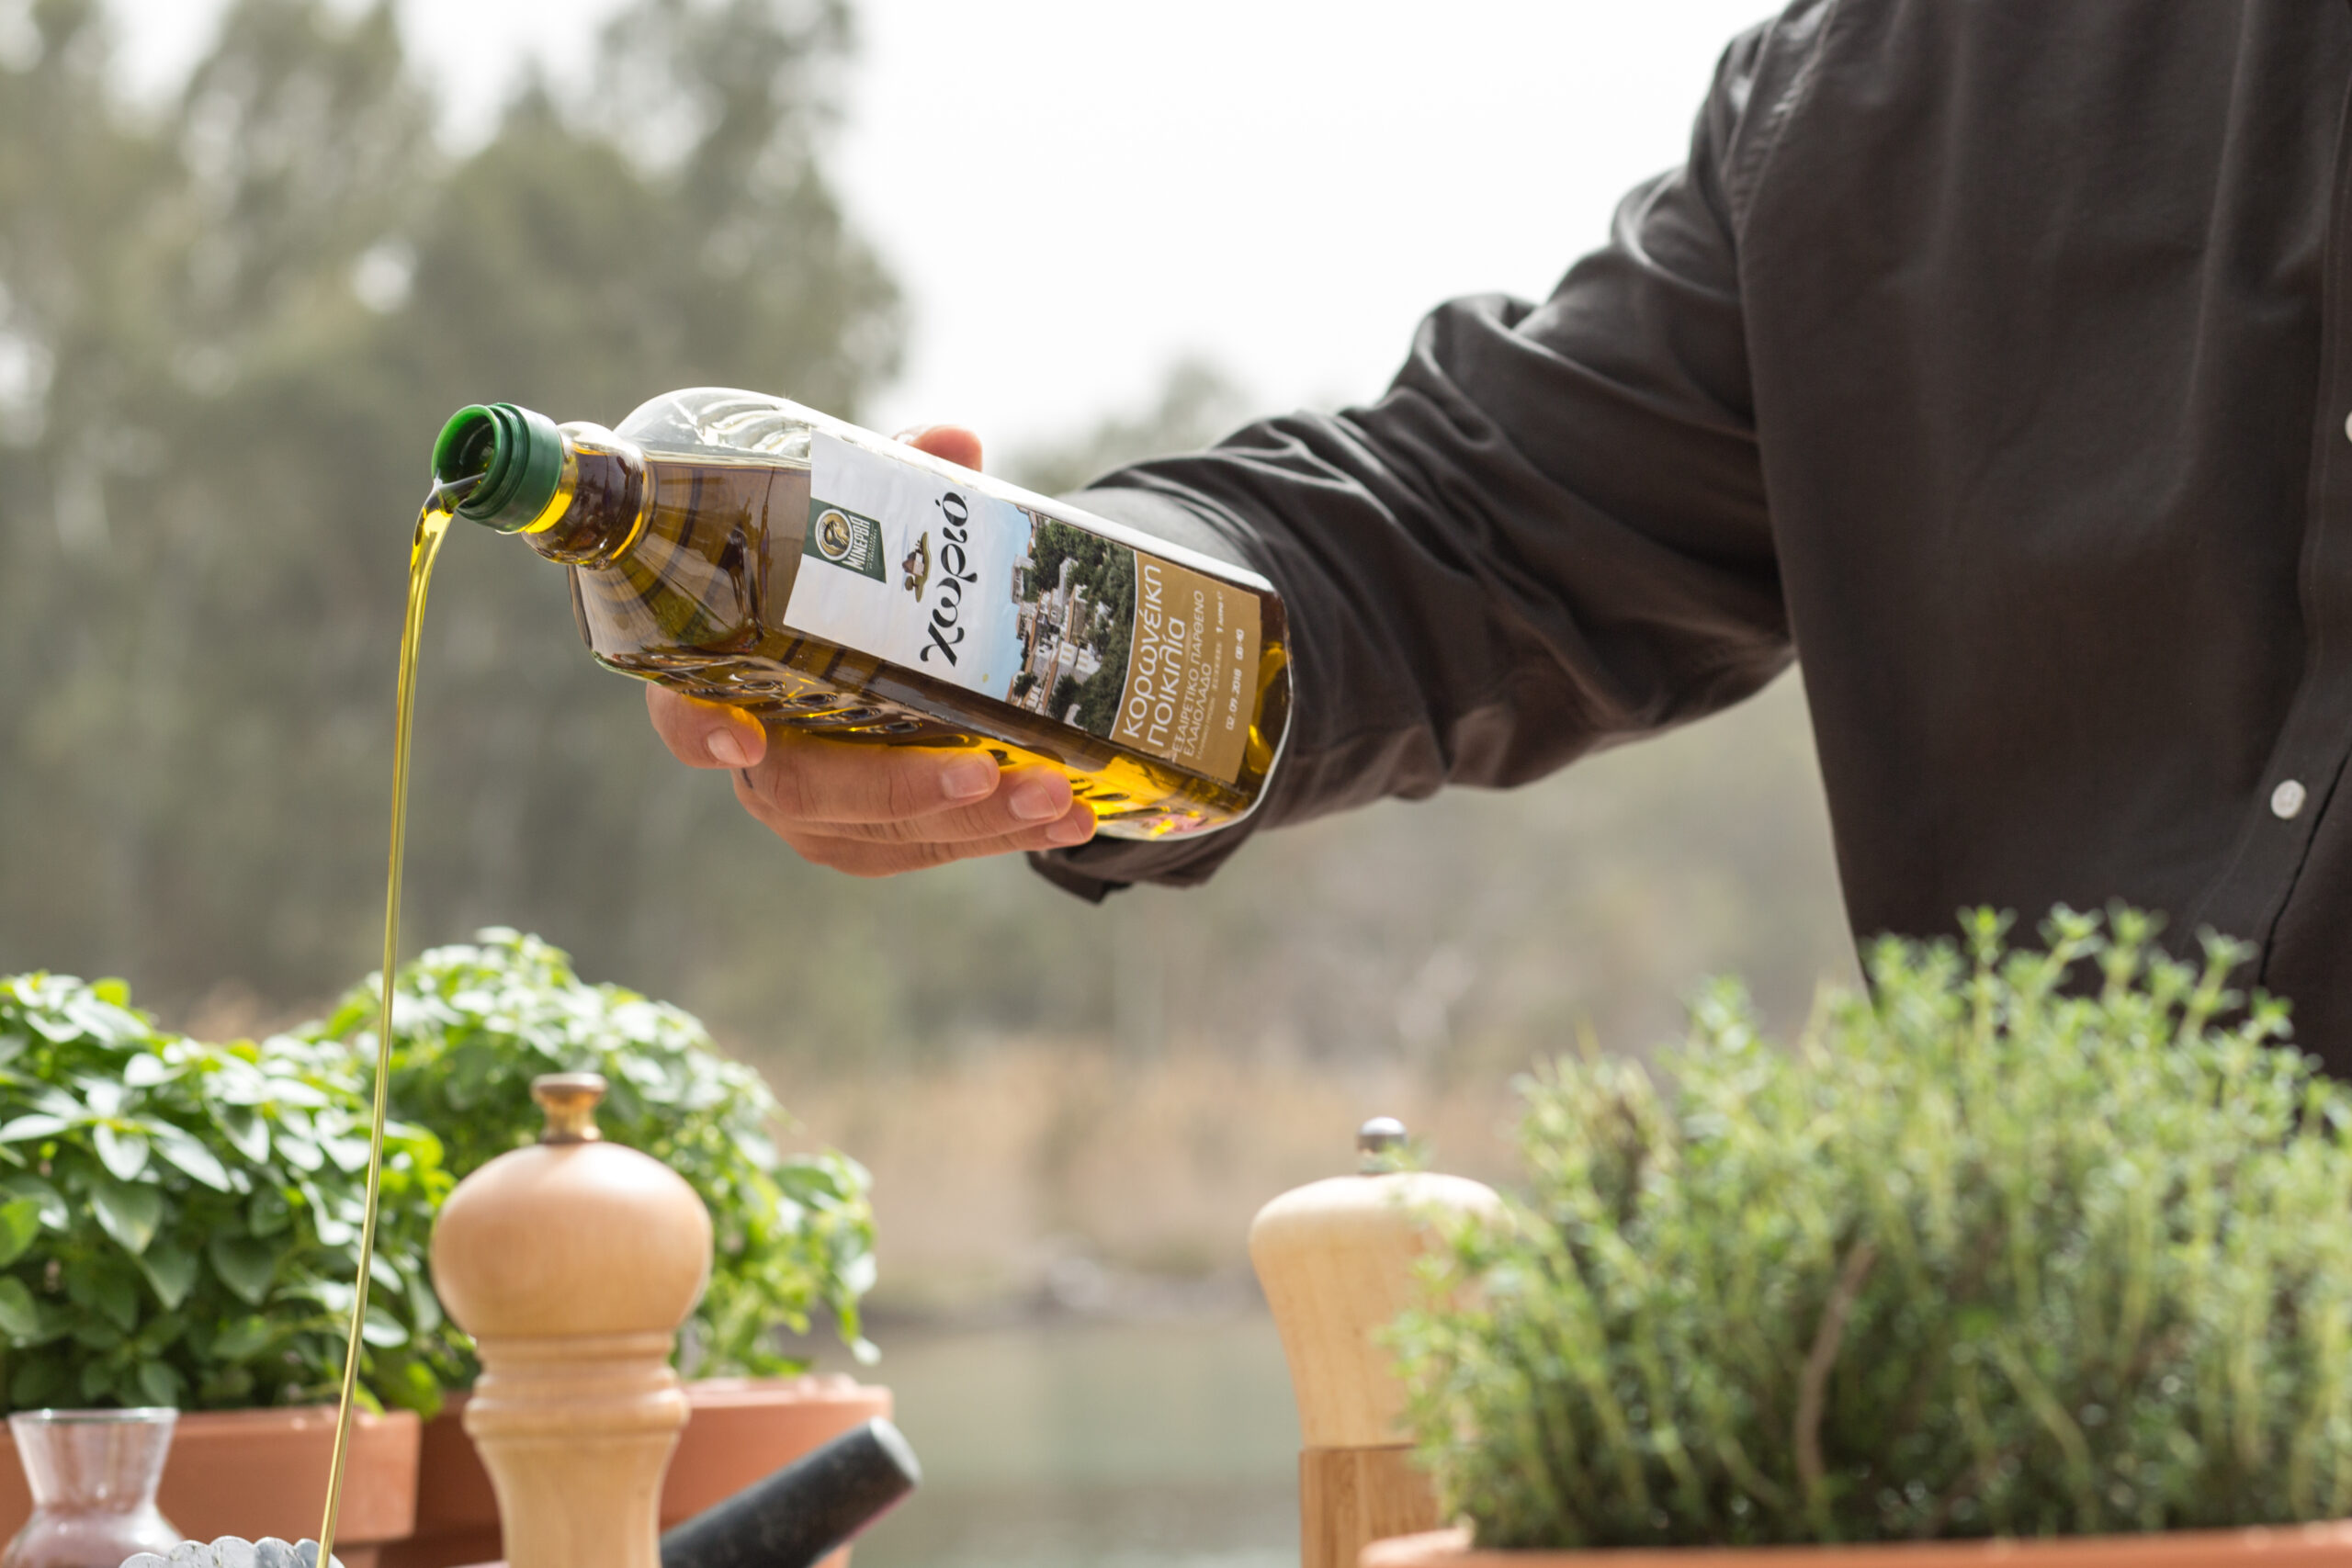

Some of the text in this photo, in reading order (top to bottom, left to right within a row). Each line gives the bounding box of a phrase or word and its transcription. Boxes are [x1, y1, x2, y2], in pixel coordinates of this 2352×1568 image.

[1172, 590, 1204, 752] ΕΞΑΙΡΕΤΙΚΟ ΠΑΡΘΕΝΟ
[1183, 662, 1212, 757] ΕΛΑΙΟΛΑΔΟ
